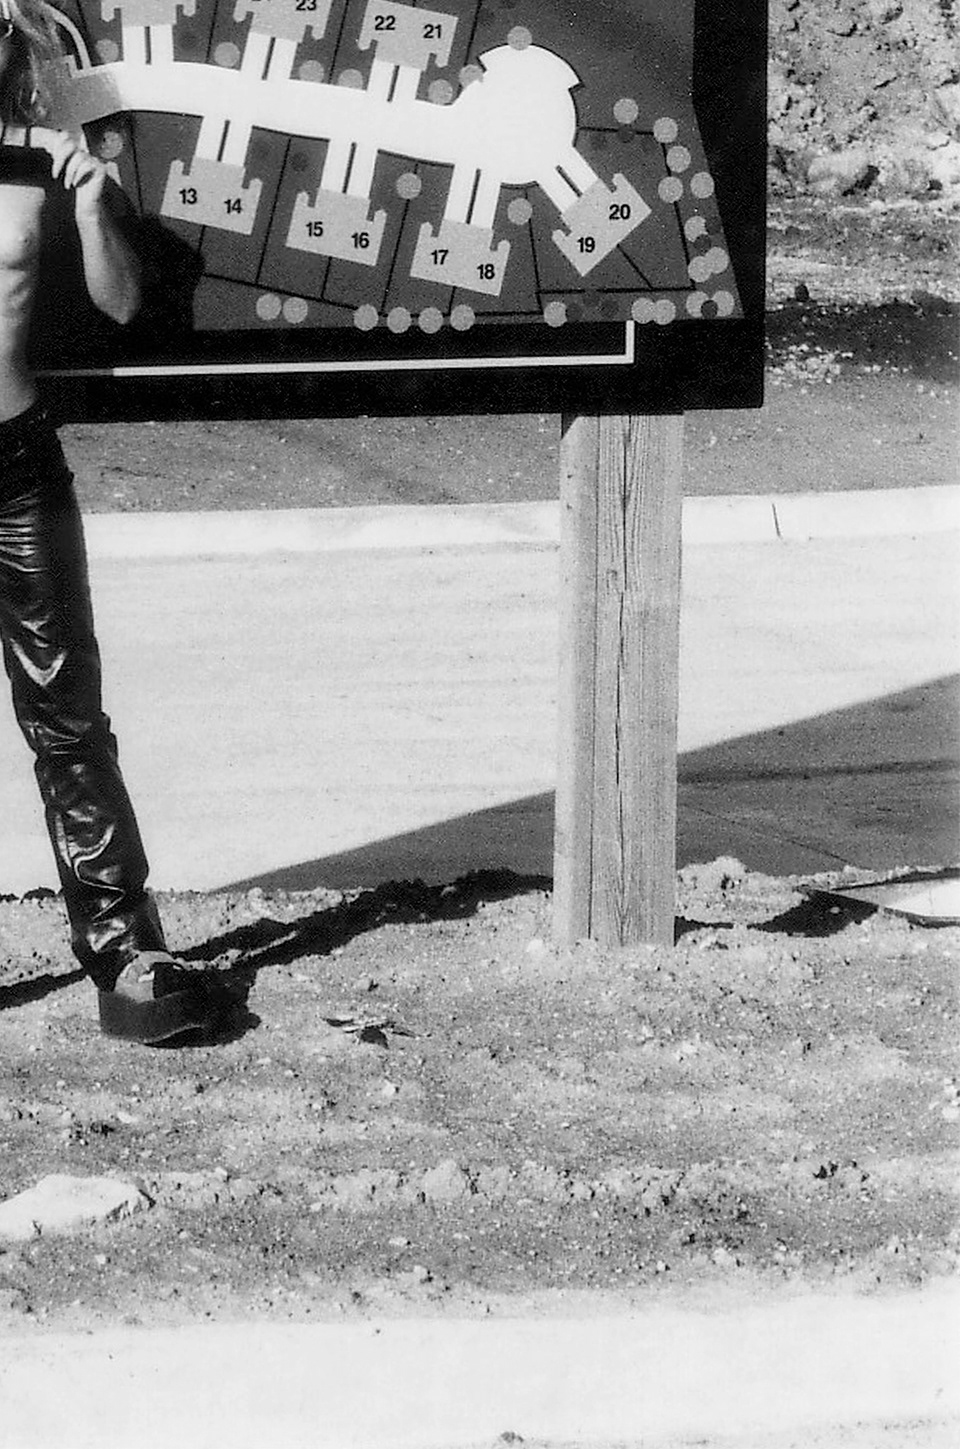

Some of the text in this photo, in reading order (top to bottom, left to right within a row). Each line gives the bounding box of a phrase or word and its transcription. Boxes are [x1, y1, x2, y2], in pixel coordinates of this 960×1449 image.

[374, 14, 396, 31] 22
[423, 23, 442, 39] 21
[178, 187, 198, 205] 13
[223, 198, 243, 215] 14
[608, 203, 631, 221] 20
[305, 220, 324, 238] 15
[351, 231, 370, 249] 16
[576, 236, 596, 254] 19
[430, 249, 449, 266] 17
[476, 263, 496, 280] 18
